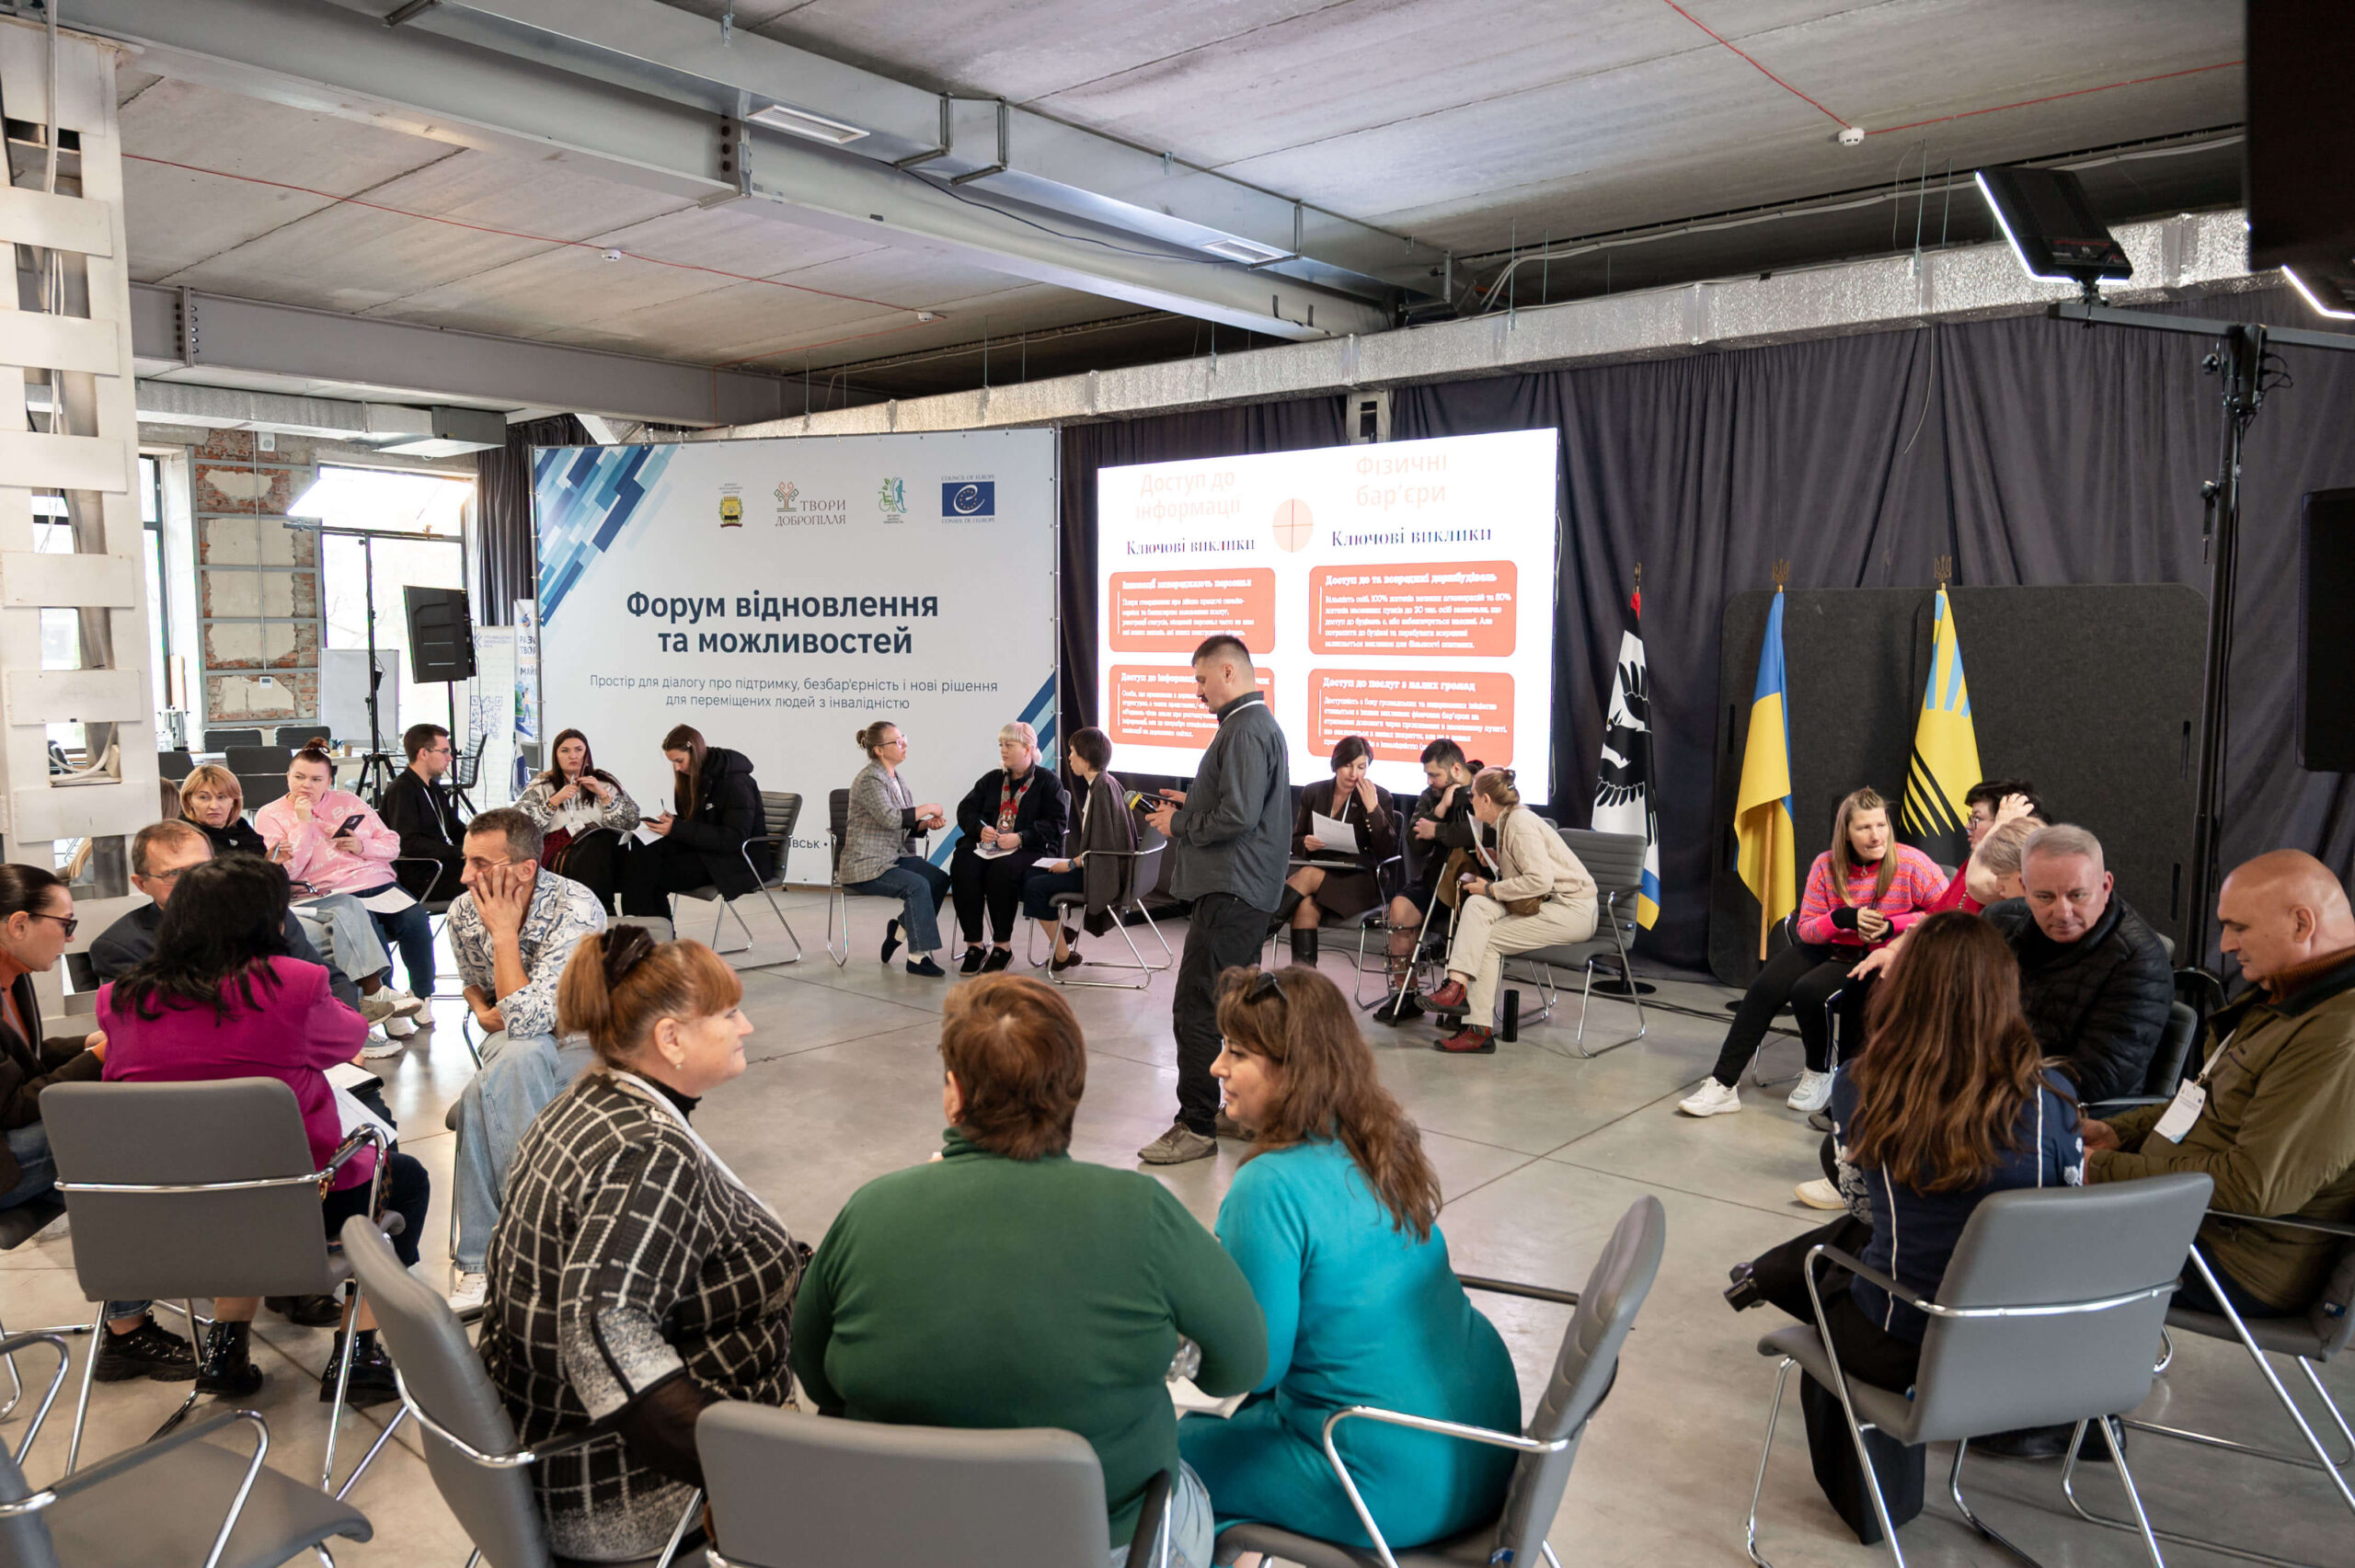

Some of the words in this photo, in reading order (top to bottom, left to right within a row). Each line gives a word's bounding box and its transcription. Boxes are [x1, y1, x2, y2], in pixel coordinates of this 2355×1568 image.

[1356, 455, 1448, 476] Фізичні
[1141, 473, 1206, 498] Доступ
[1211, 471, 1235, 491] до
[799, 499, 846, 512] ТВОРИ
[1136, 498, 1241, 523] інформації
[775, 514, 846, 528] ДОБРОПІЛЛЯ
[1127, 537, 1186, 555] Ключові
[1190, 539, 1255, 553] виклики
[1333, 527, 1405, 547] Ключові
[1411, 529, 1491, 544] виклики
[1326, 575, 1358, 586] Доступ
[1359, 576, 1371, 586] до
[1372, 576, 1383, 584] та
[627, 591, 725, 624] Форум
[737, 589, 937, 619] відновлення
[658, 633, 688, 653] та
[699, 626, 912, 655] можливостей
[590, 675, 636, 690] Простір
[638, 678, 659, 690] для
[662, 677, 706, 692] діалогу
[709, 680, 731, 692] про
[735, 677, 799, 692] підтримку,
[803, 677, 899, 693] безбар'єрність
[902, 677, 906, 691] і
[910, 678, 937, 692] нові
[941, 678, 998, 694] рішення
[1323, 677, 1354, 689] Доступ
[1356, 680, 1367, 689] до
[665, 695, 687, 706] для
[690, 694, 771, 709] переміщених
[775, 695, 815, 709] людей
[819, 697, 826, 706] з
[829, 695, 910, 710] інвалідністю
